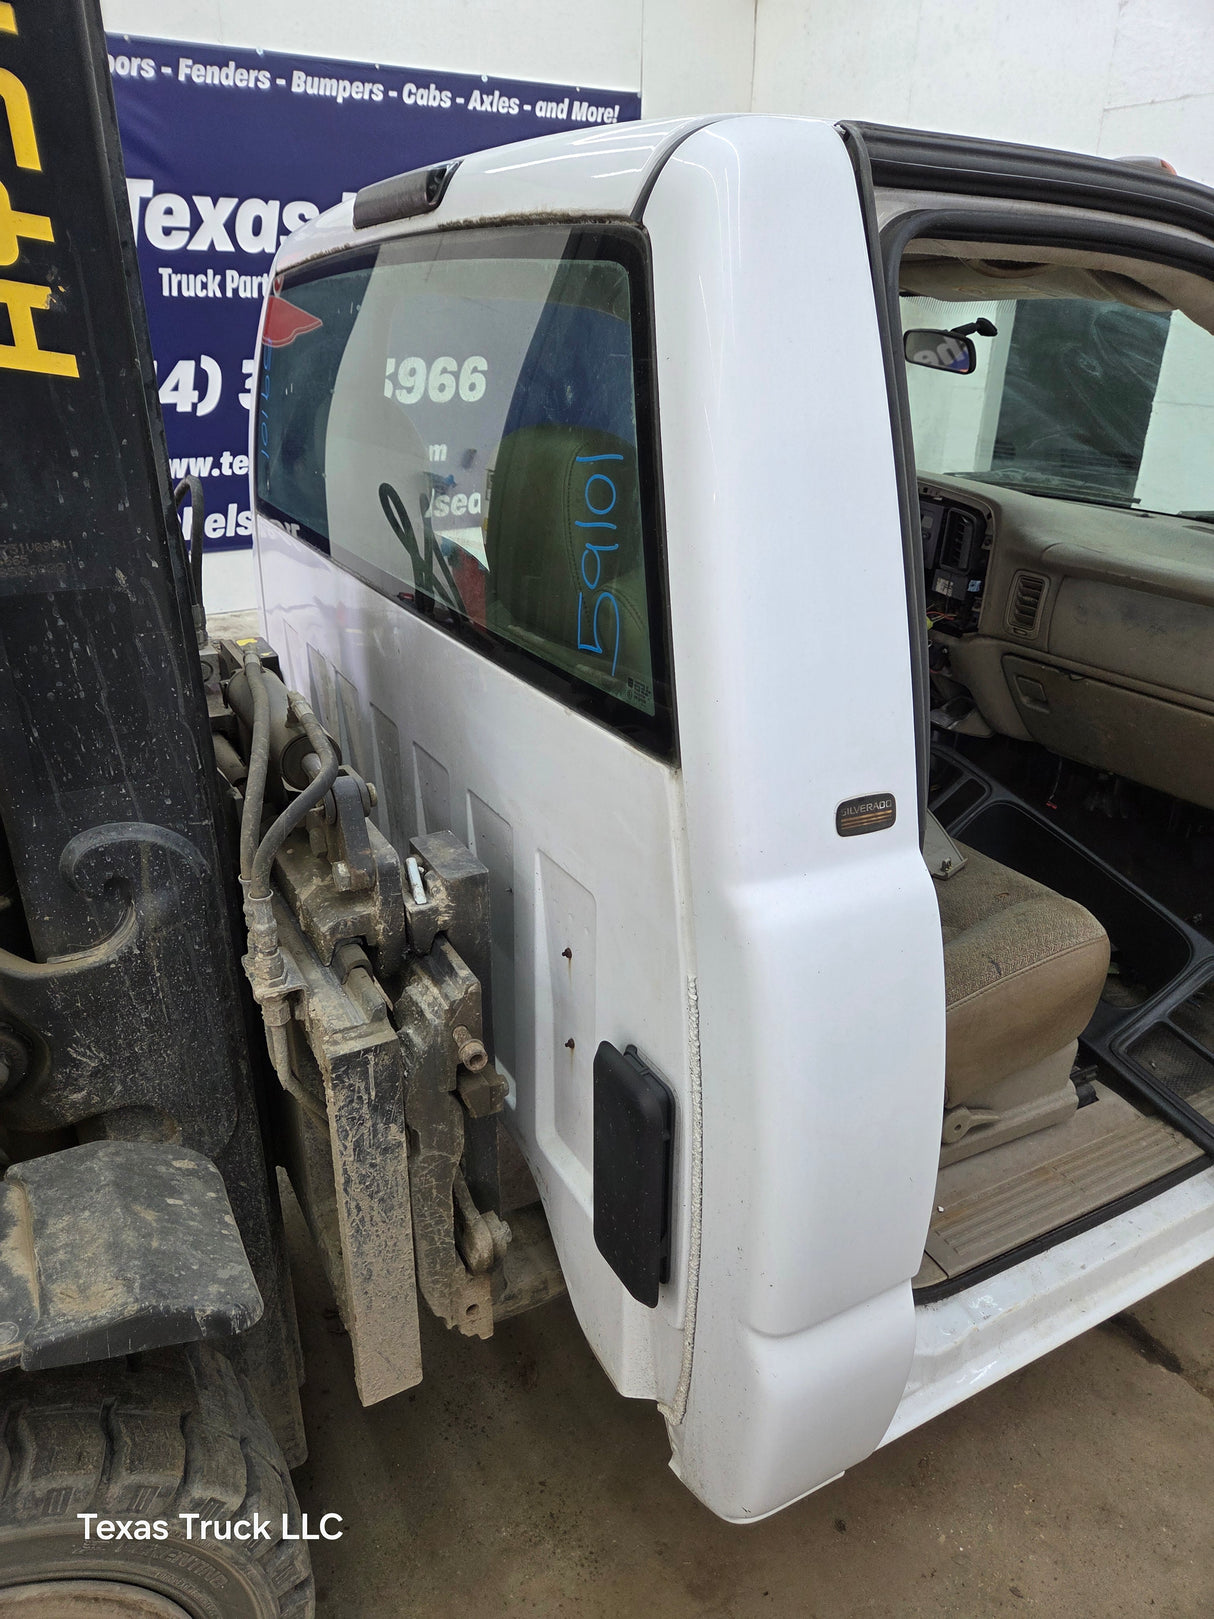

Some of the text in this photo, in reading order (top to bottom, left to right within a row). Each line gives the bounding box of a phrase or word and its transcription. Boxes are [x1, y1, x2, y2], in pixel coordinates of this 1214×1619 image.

[178, 57, 270, 90] Fenders
[291, 70, 384, 104] Bumpers
[402, 82, 452, 109] Cabs
[468, 89, 519, 115] Axles
[535, 98, 570, 120] and
[571, 101, 620, 123] More!
[158, 267, 222, 298] Truck
[576, 454, 624, 677] 59101
[841, 800, 892, 816] SILVERADO
